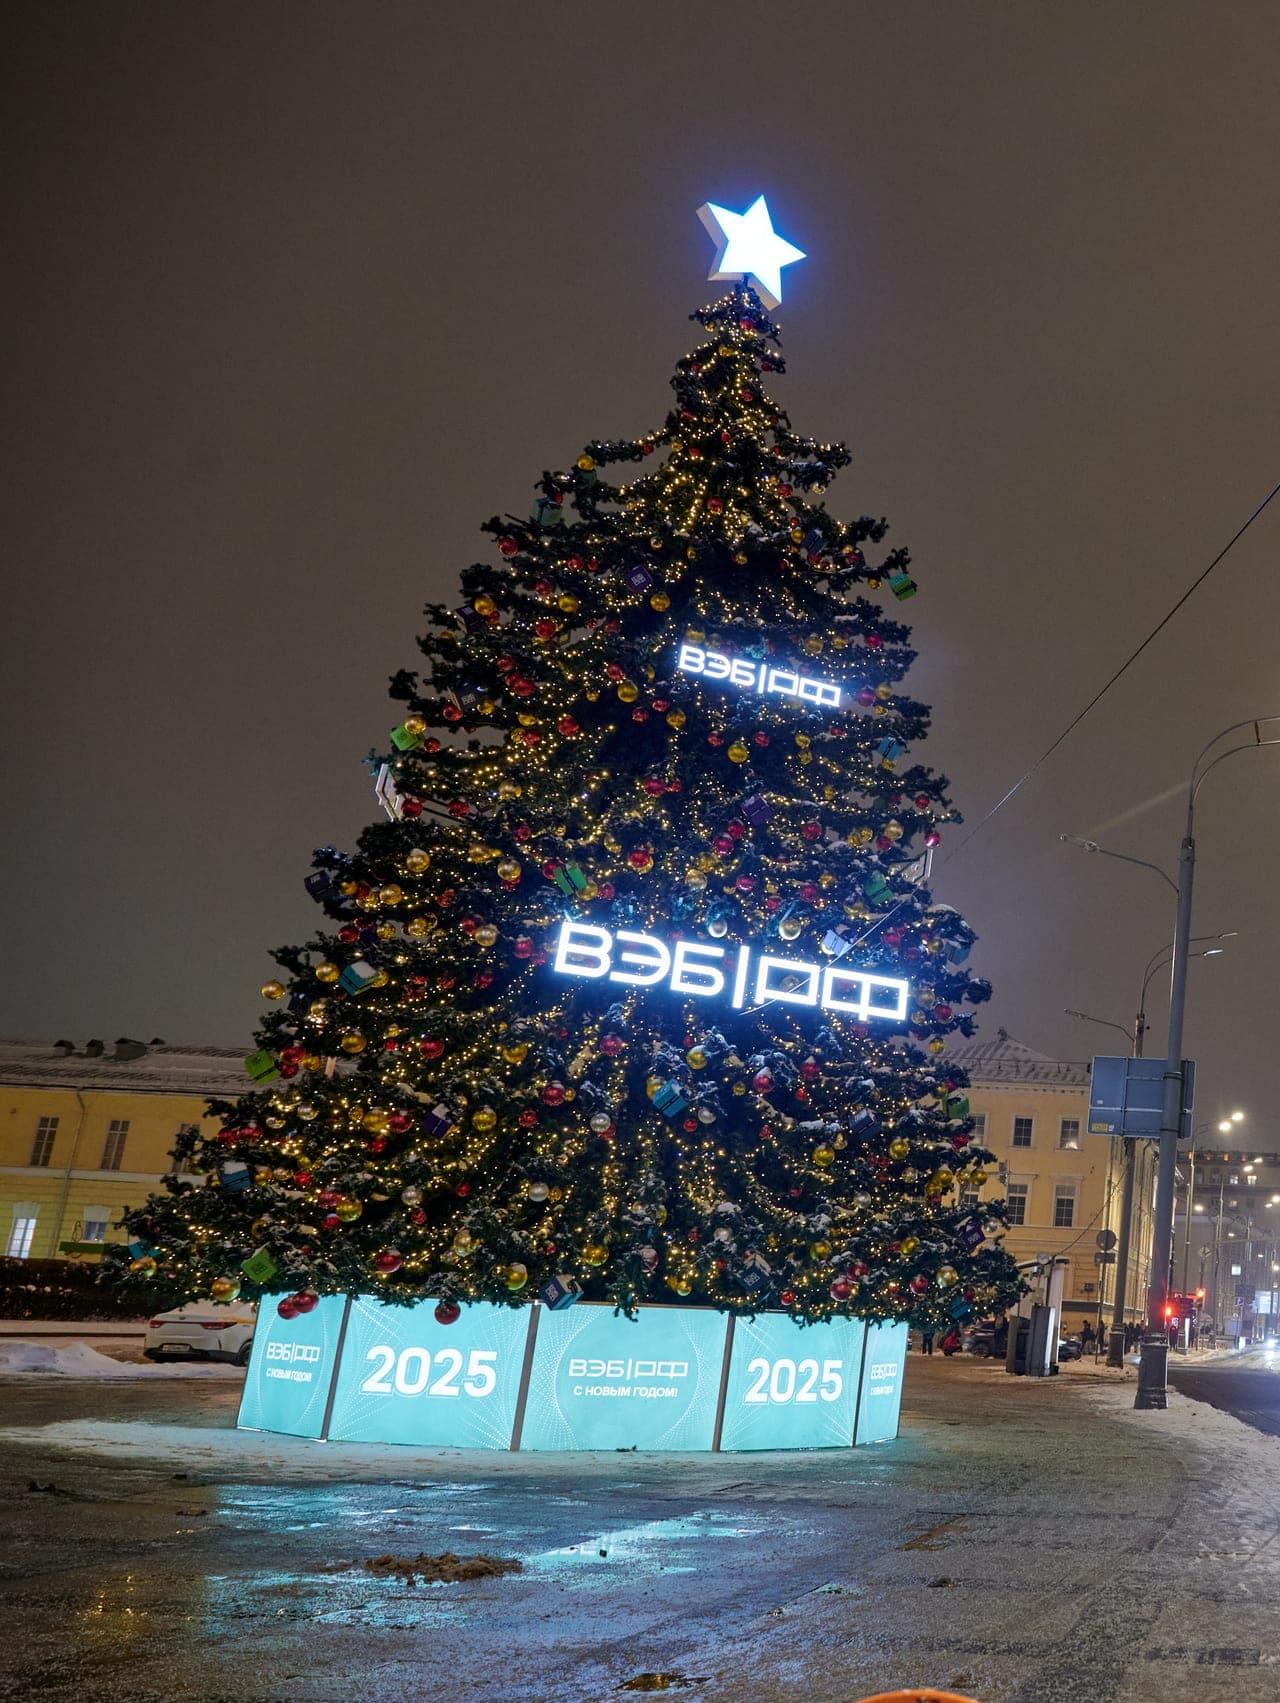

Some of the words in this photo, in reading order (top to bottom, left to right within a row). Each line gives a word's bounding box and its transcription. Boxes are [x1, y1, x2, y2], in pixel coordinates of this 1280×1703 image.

[361, 1344, 498, 1398] 2025
[573, 1386, 583, 1396] С
[585, 1386, 631, 1397] НОВЫМ
[632, 1387, 678, 1398] ГОДОМ!
[744, 1357, 843, 1402] 2025
